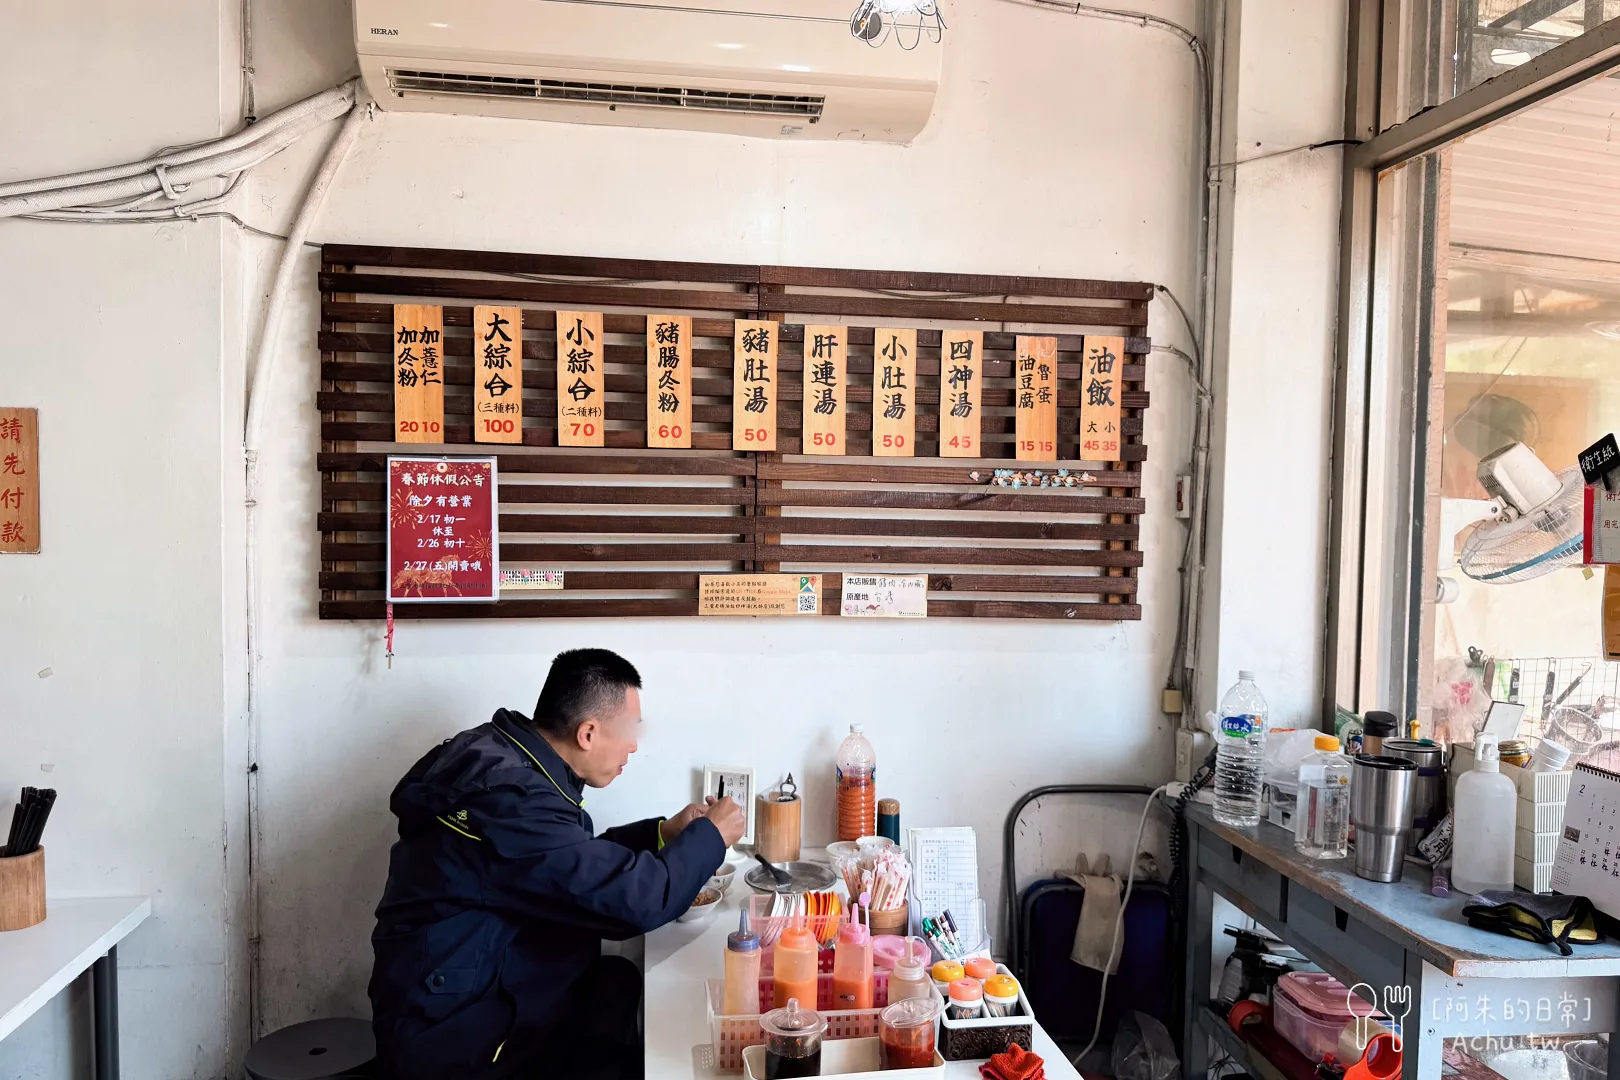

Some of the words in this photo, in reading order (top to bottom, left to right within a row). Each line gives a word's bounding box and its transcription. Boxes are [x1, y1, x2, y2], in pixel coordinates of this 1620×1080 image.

[370, 27, 399, 36] HERAN
[397, 326, 419, 387] 加冬粉
[419, 326, 441, 386] 加薏仁
[484, 313, 513, 398] 大綜合
[566, 318, 595, 402] 小綜合
[655, 322, 680, 413] 豬腸冬粉
[742, 328, 770, 413] 豬肚湯
[811, 334, 838, 415] 肝連湯
[881, 335, 908, 419] 小肚湯
[948, 340, 974, 418] 四神湯
[1019, 354, 1036, 409] 油豆腐
[1036, 364, 1052, 404] 魯蛋
[1086, 347, 1116, 407] 油飯
[477, 402, 520, 414] (三種料)
[561, 406, 603, 418] (二種料)
[400, 421, 419, 433] 20
[422, 421, 440, 433] 10
[484, 419, 515, 434] 100
[570, 423, 595, 437] 70
[658, 425, 683, 439] 60
[1087, 421, 1098, 433] 大
[1104, 422, 1116, 433] 小
[744, 428, 768, 442] 50
[813, 432, 836, 446] 50
[882, 435, 905, 448] 50
[949, 435, 971, 448] 45
[1020, 441, 1035, 452] 15
[1039, 441, 1053, 452] 15
[1083, 440, 1100, 451] 45
[1101, 440, 1117, 451] 35
[1581, 444, 1616, 473] 衛生紙
[0, 417, 26, 543] 請先付款
[401, 472, 485, 487] 春節休假公告
[409, 494, 473, 508] 除夕有營業
[417, 514, 441, 524] 2/17
[443, 514, 466, 524] 初一
[432, 526, 454, 537] 休至
[417, 538, 440, 548] 2/26
[443, 538, 466, 548] 初十
[846, 577, 877, 586] 本店販售
[845, 592, 869, 601] 原產地
[1579, 784, 1586, 794] 2
